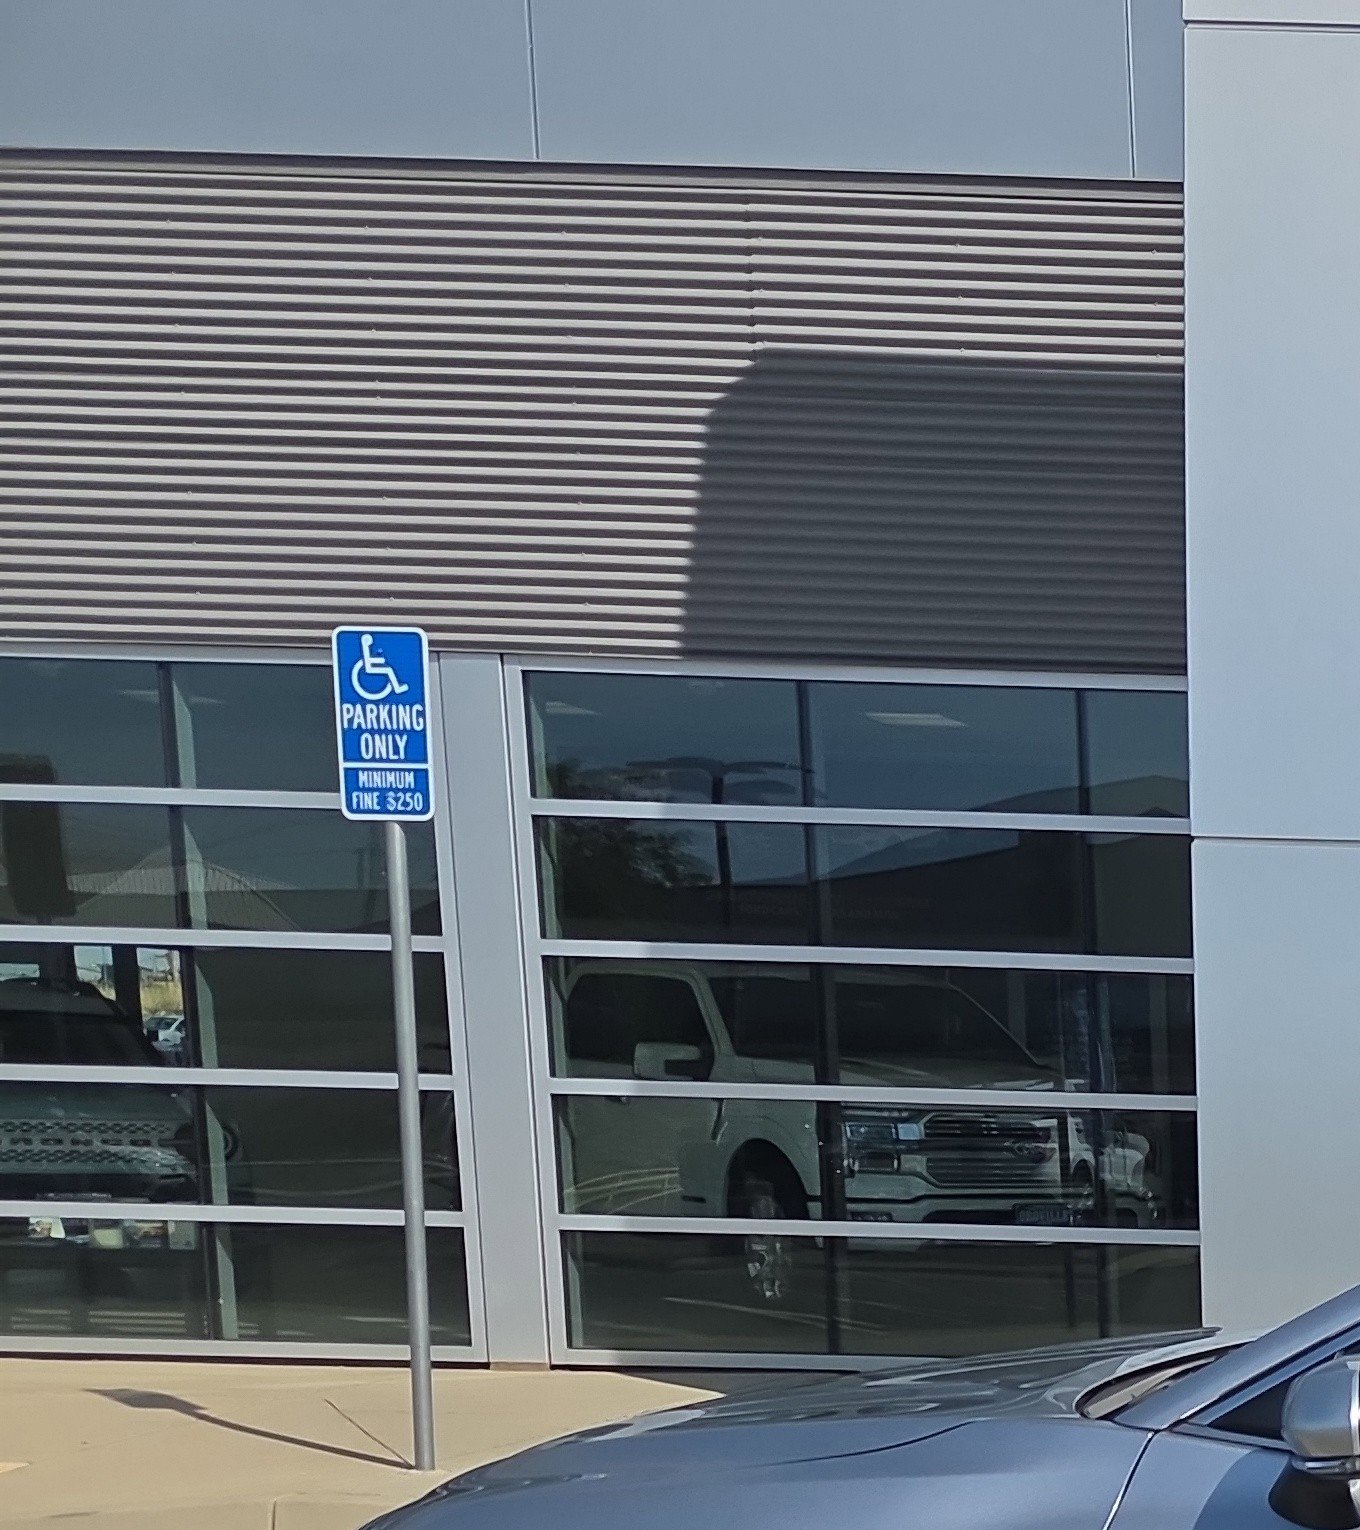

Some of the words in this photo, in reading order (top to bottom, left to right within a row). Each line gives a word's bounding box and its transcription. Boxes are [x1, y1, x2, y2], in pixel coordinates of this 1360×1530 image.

[342, 703, 424, 732] PARKING
[361, 733, 408, 760] ONLY
[358, 770, 415, 789] MINIMUM
[352, 791, 381, 811] FINE
[386, 791, 424, 812] $250
